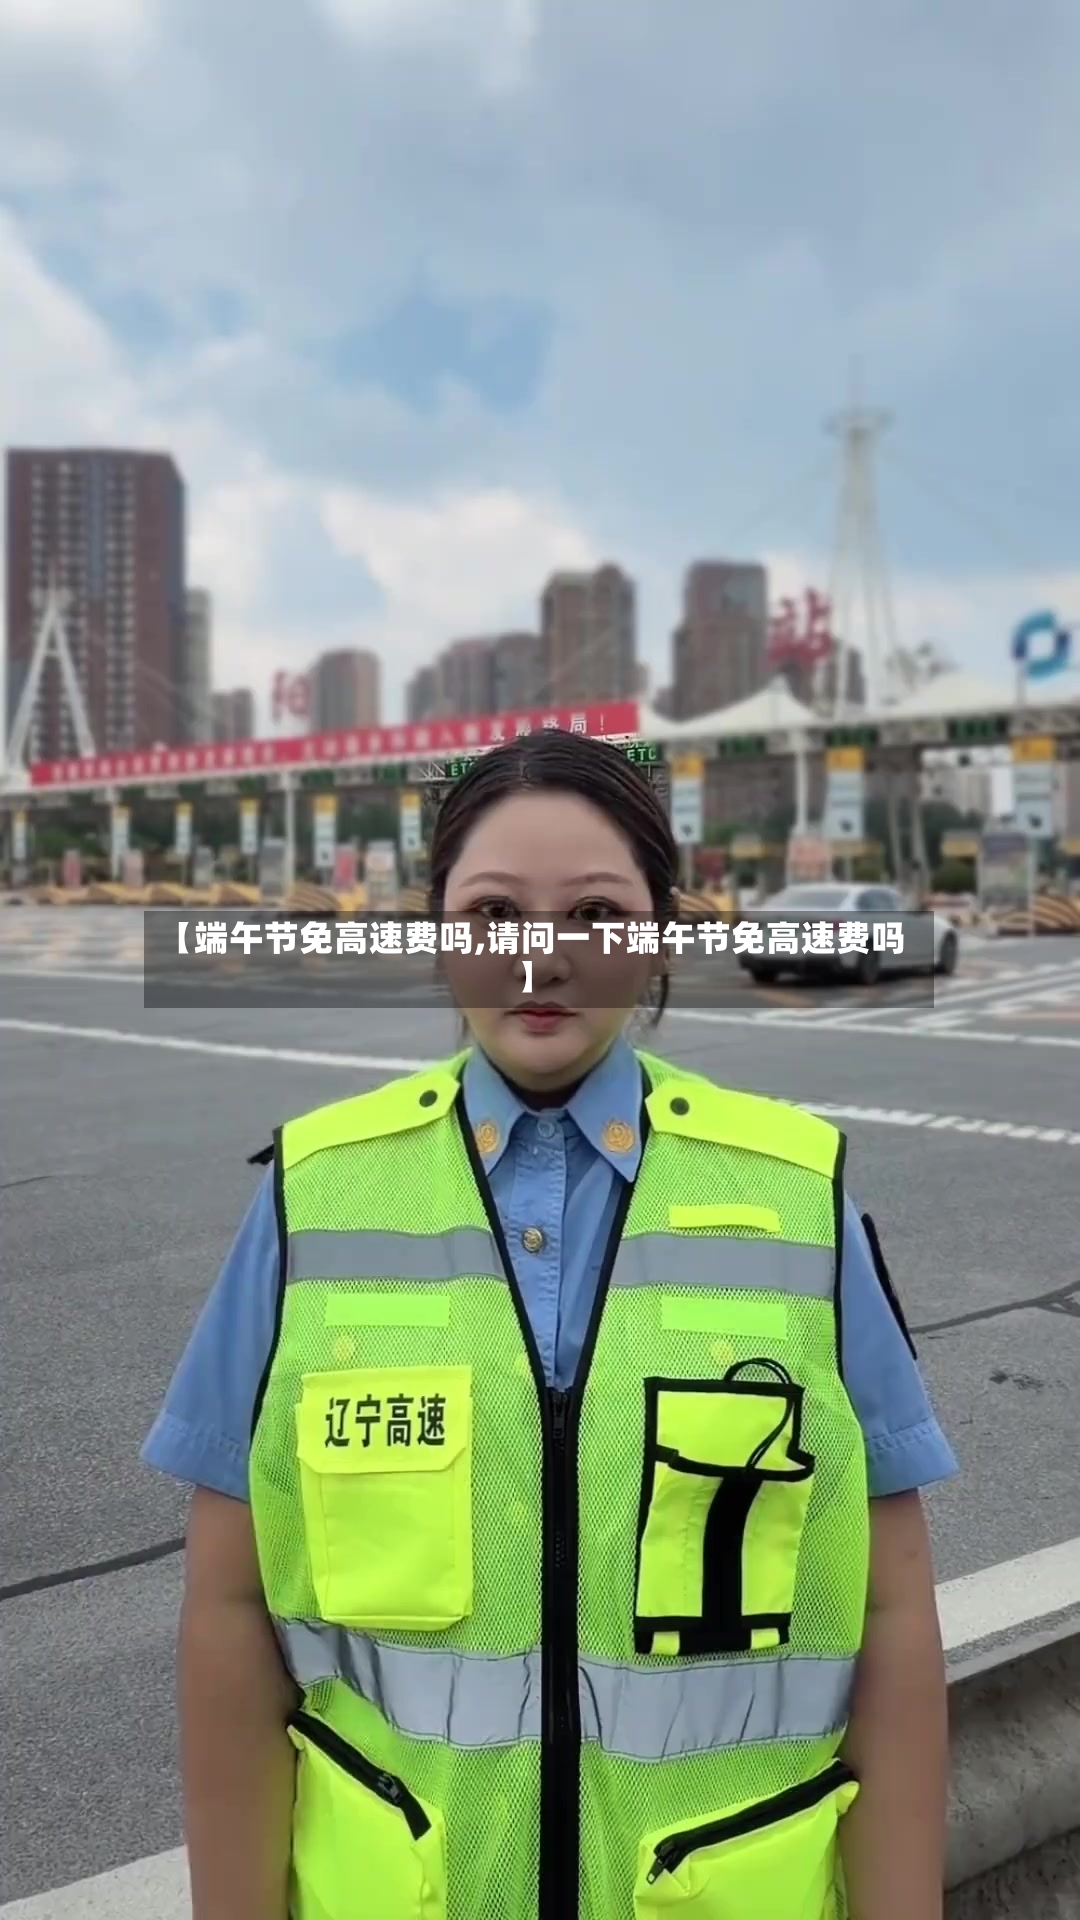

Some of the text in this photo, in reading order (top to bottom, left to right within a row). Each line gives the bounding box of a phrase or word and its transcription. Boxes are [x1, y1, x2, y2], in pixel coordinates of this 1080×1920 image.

[626, 748, 657, 762] ETC
[450, 761, 476, 777] ET
[324, 1393, 446, 1448] 辽宁高速
